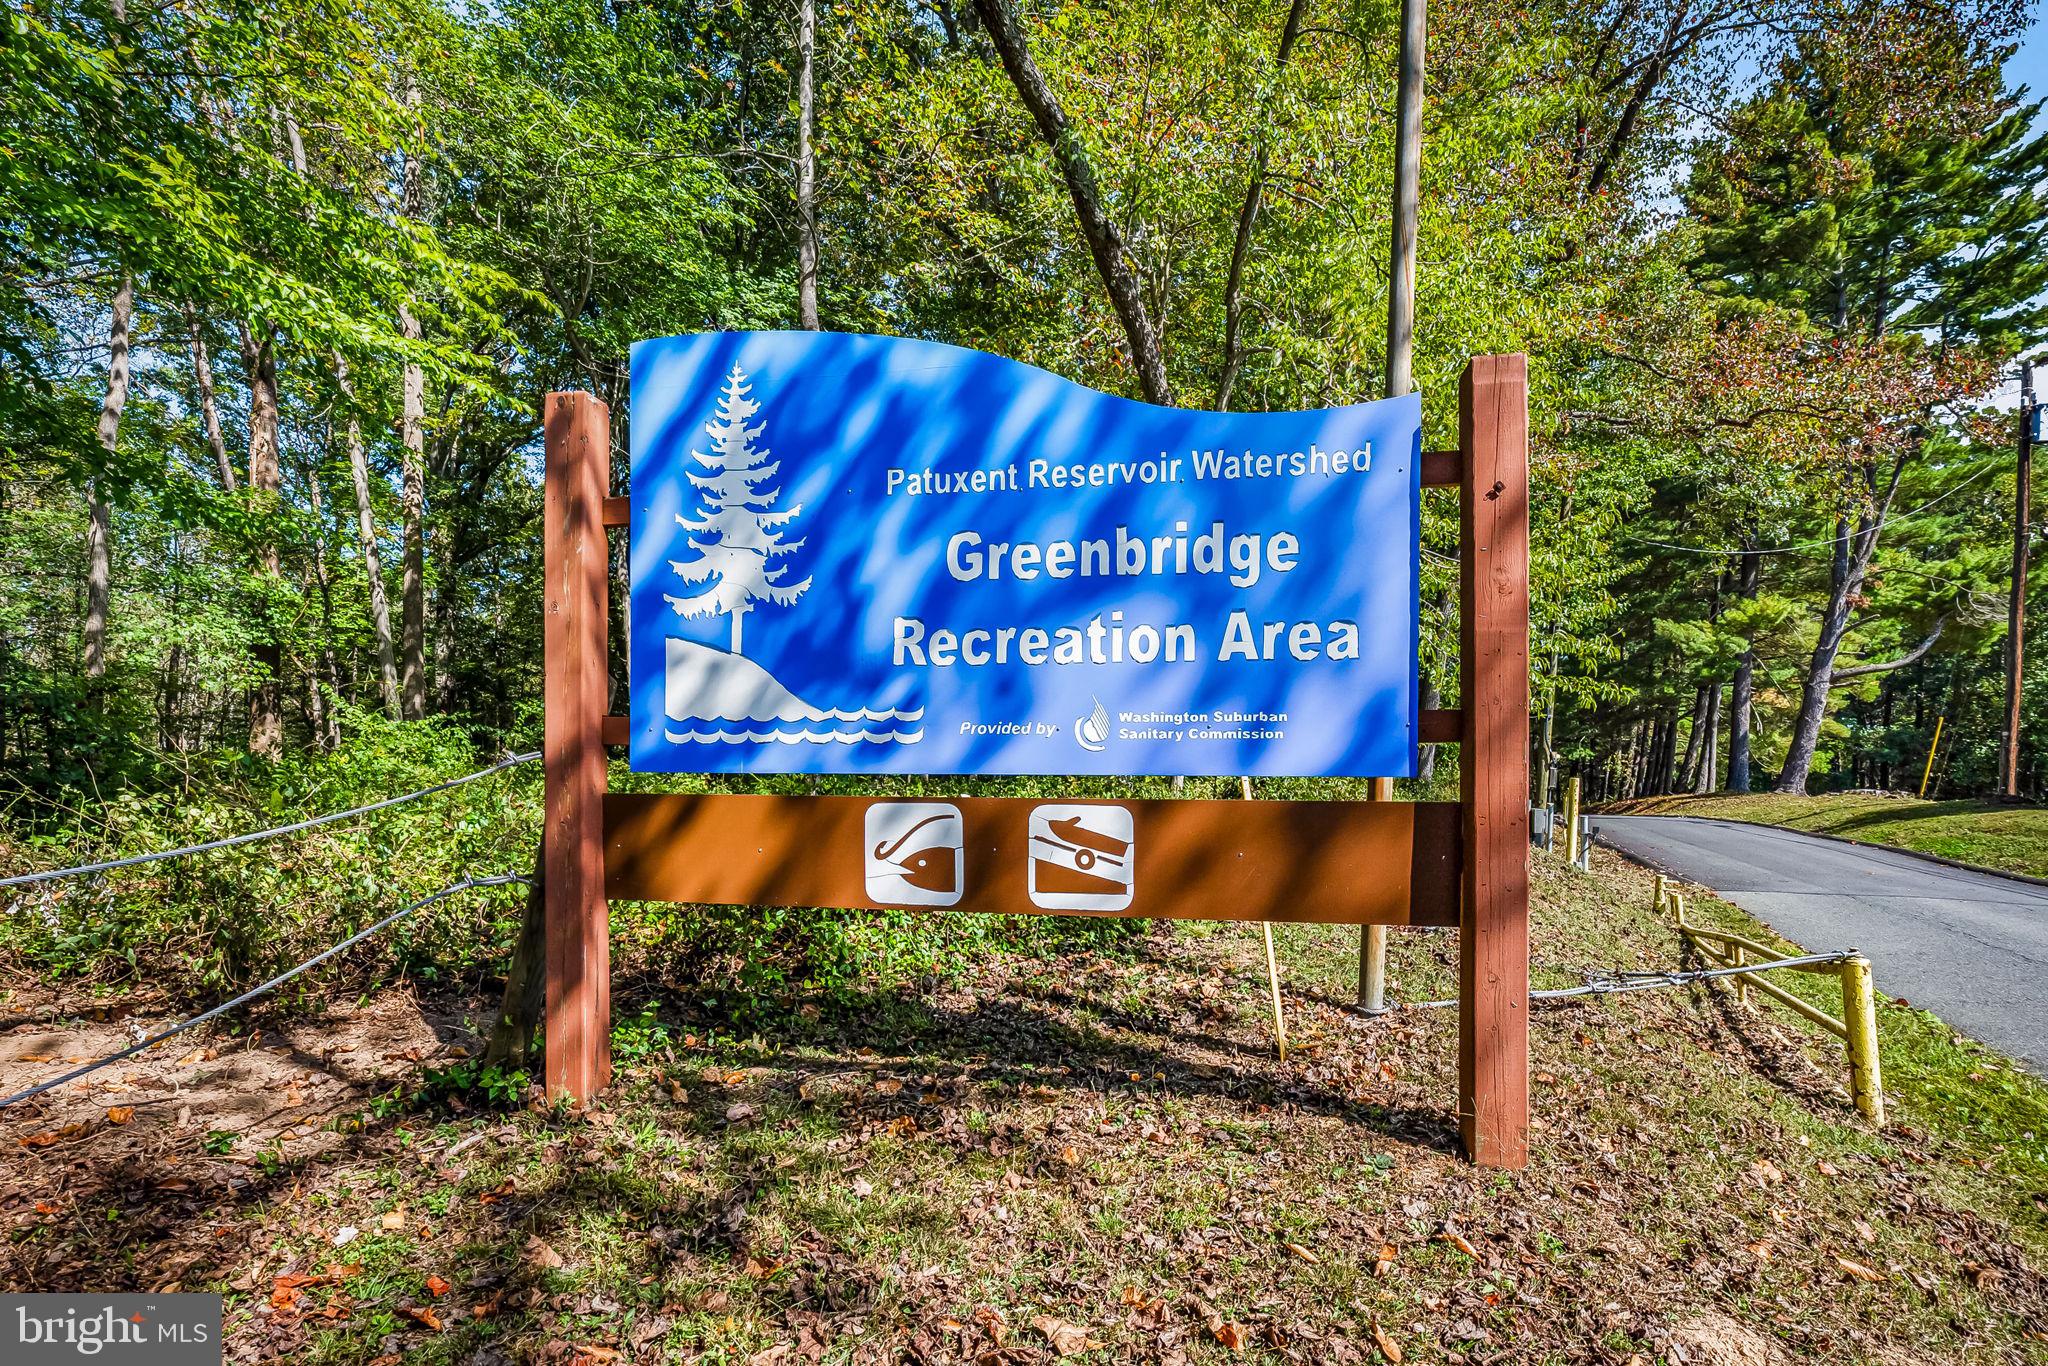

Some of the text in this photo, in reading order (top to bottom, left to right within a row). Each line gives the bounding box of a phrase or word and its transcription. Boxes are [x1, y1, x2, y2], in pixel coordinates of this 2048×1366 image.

[887, 440, 1372, 496] Patuxent Reservoir Watershed
[946, 520, 1300, 588] Greenbridge
[892, 608, 1361, 666] Recreation Area
[959, 721, 1057, 738] Provided by
[1118, 710, 1288, 724] Washington Suburban
[1119, 728, 1285, 742] Sanitary Commission
